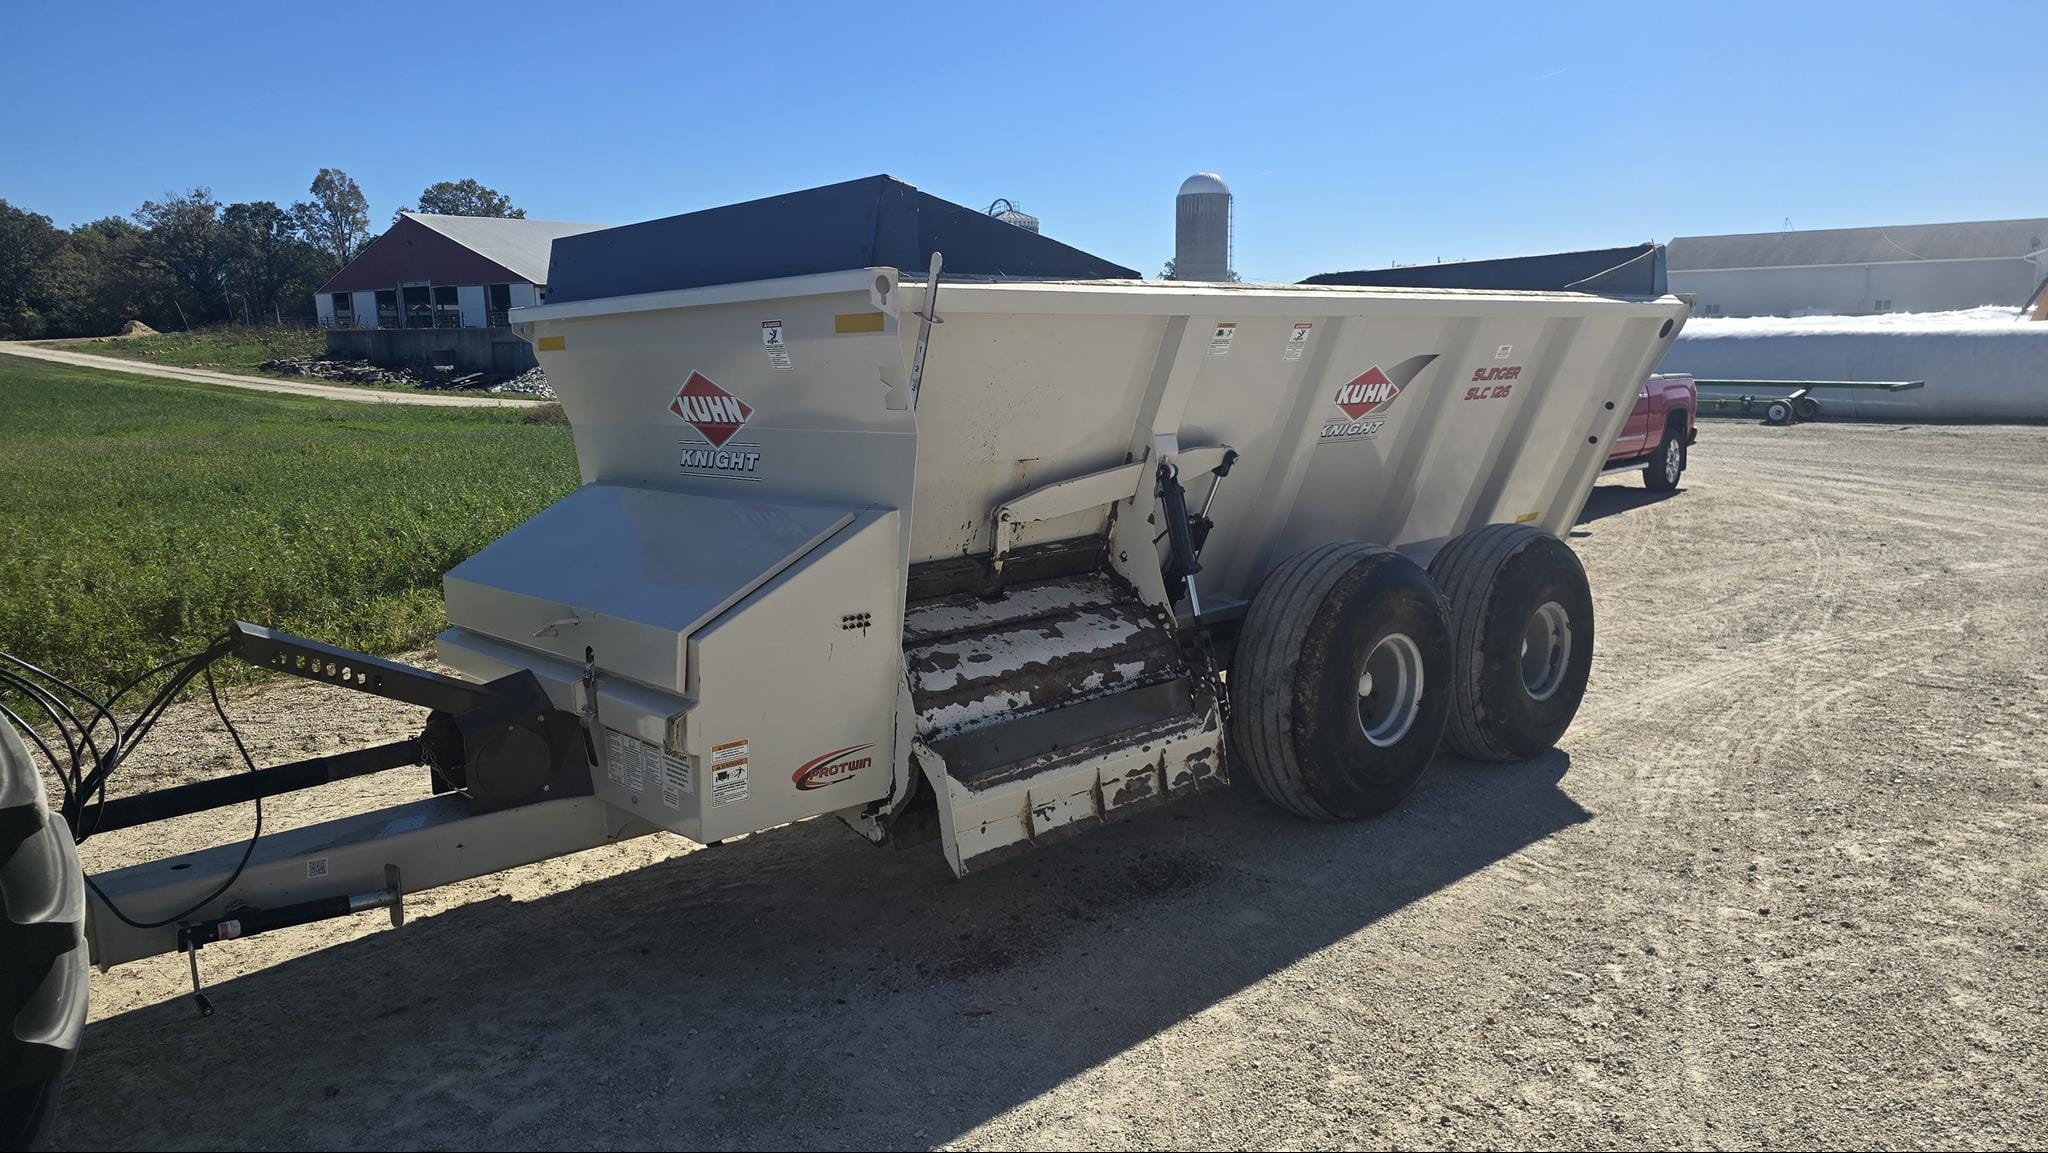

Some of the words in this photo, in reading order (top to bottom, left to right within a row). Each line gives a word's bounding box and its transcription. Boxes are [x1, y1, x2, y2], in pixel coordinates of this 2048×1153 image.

[1472, 366, 1522, 381] SLINGER
[1336, 383, 1392, 405] KUHN
[1464, 386, 1492, 401] SLC
[1490, 384, 1513, 399] 126
[676, 395, 746, 424] KUHN
[1320, 421, 1384, 438] KNIGHT
[680, 449, 760, 472] KNIGHT
[808, 757, 872, 781] PROTWIN
